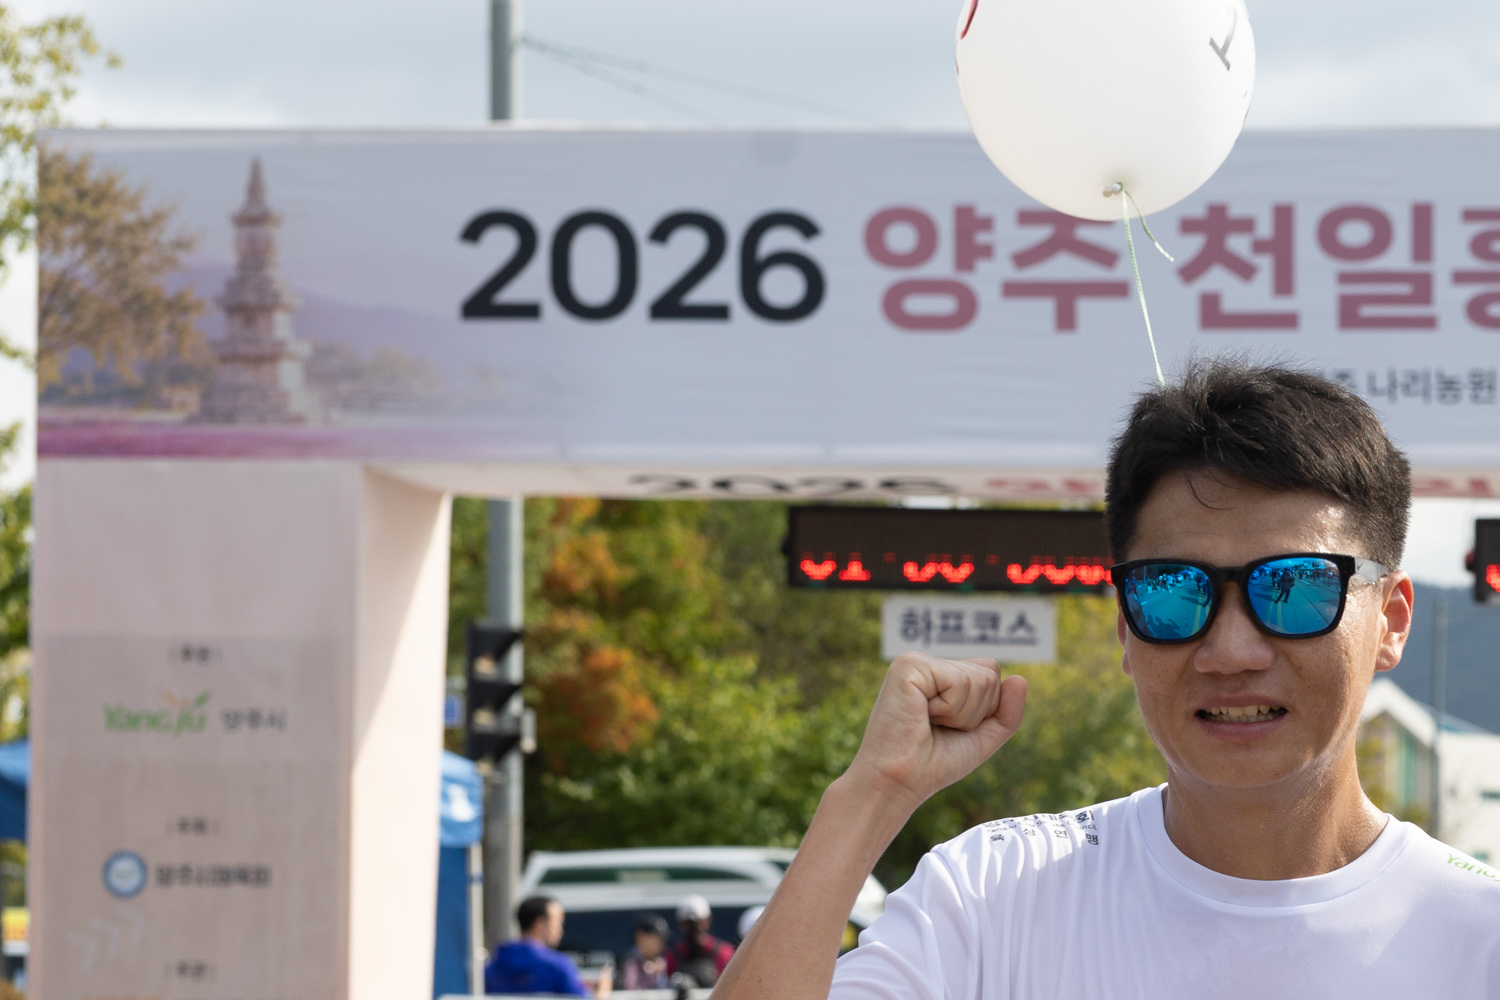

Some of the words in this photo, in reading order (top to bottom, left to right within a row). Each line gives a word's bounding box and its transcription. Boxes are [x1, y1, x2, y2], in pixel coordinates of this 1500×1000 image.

[459, 208, 827, 324] 2026
[863, 203, 1131, 332] 양주
[1366, 368, 1498, 404] 나리농원
[900, 607, 1039, 646] 하프코스
